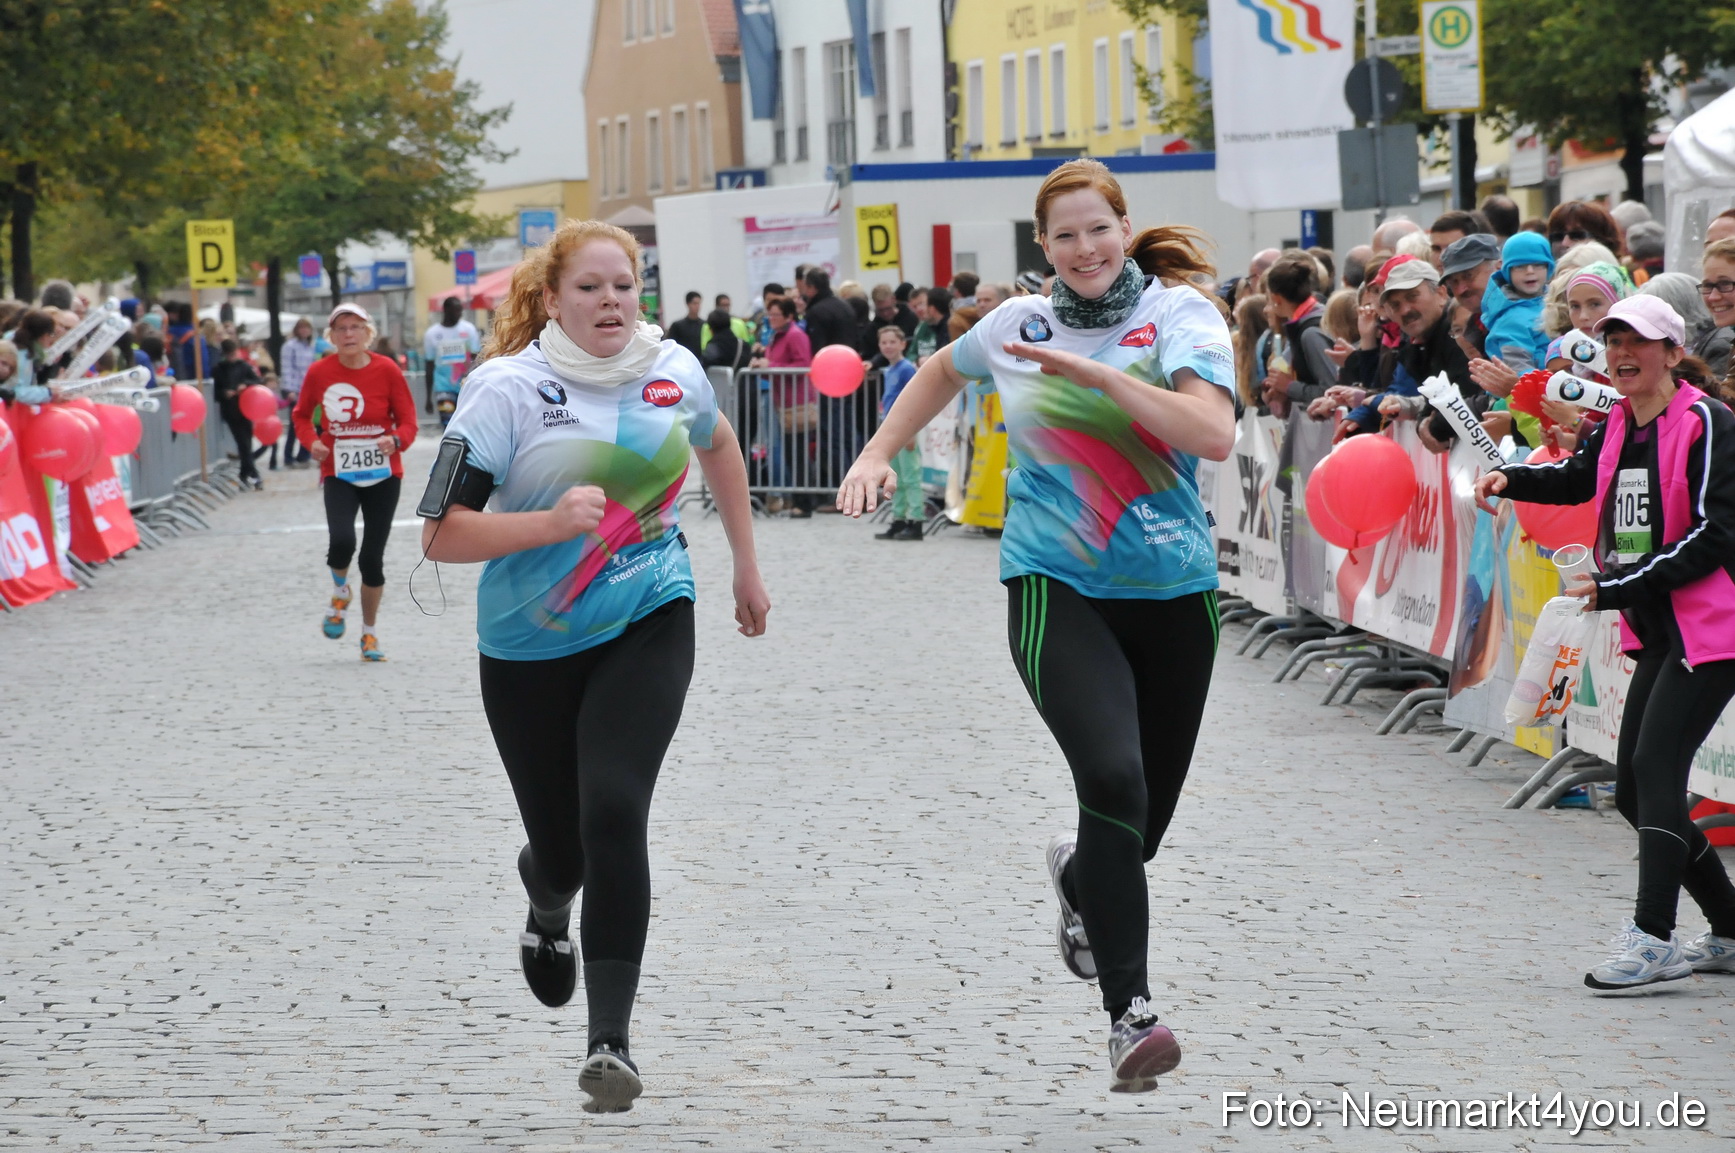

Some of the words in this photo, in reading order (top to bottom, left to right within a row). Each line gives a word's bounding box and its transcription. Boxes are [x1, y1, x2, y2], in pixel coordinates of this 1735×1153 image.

[1441, 15, 1460, 39] H
[861, 208, 895, 220] Block
[193, 225, 226, 236] Block
[868, 224, 890, 255] D
[201, 241, 224, 273] D
[543, 417, 580, 428] Neumarkt
[340, 448, 385, 469] 2485
[1132, 503, 1160, 519] 16.
[608, 554, 658, 586] Stadtlauf
